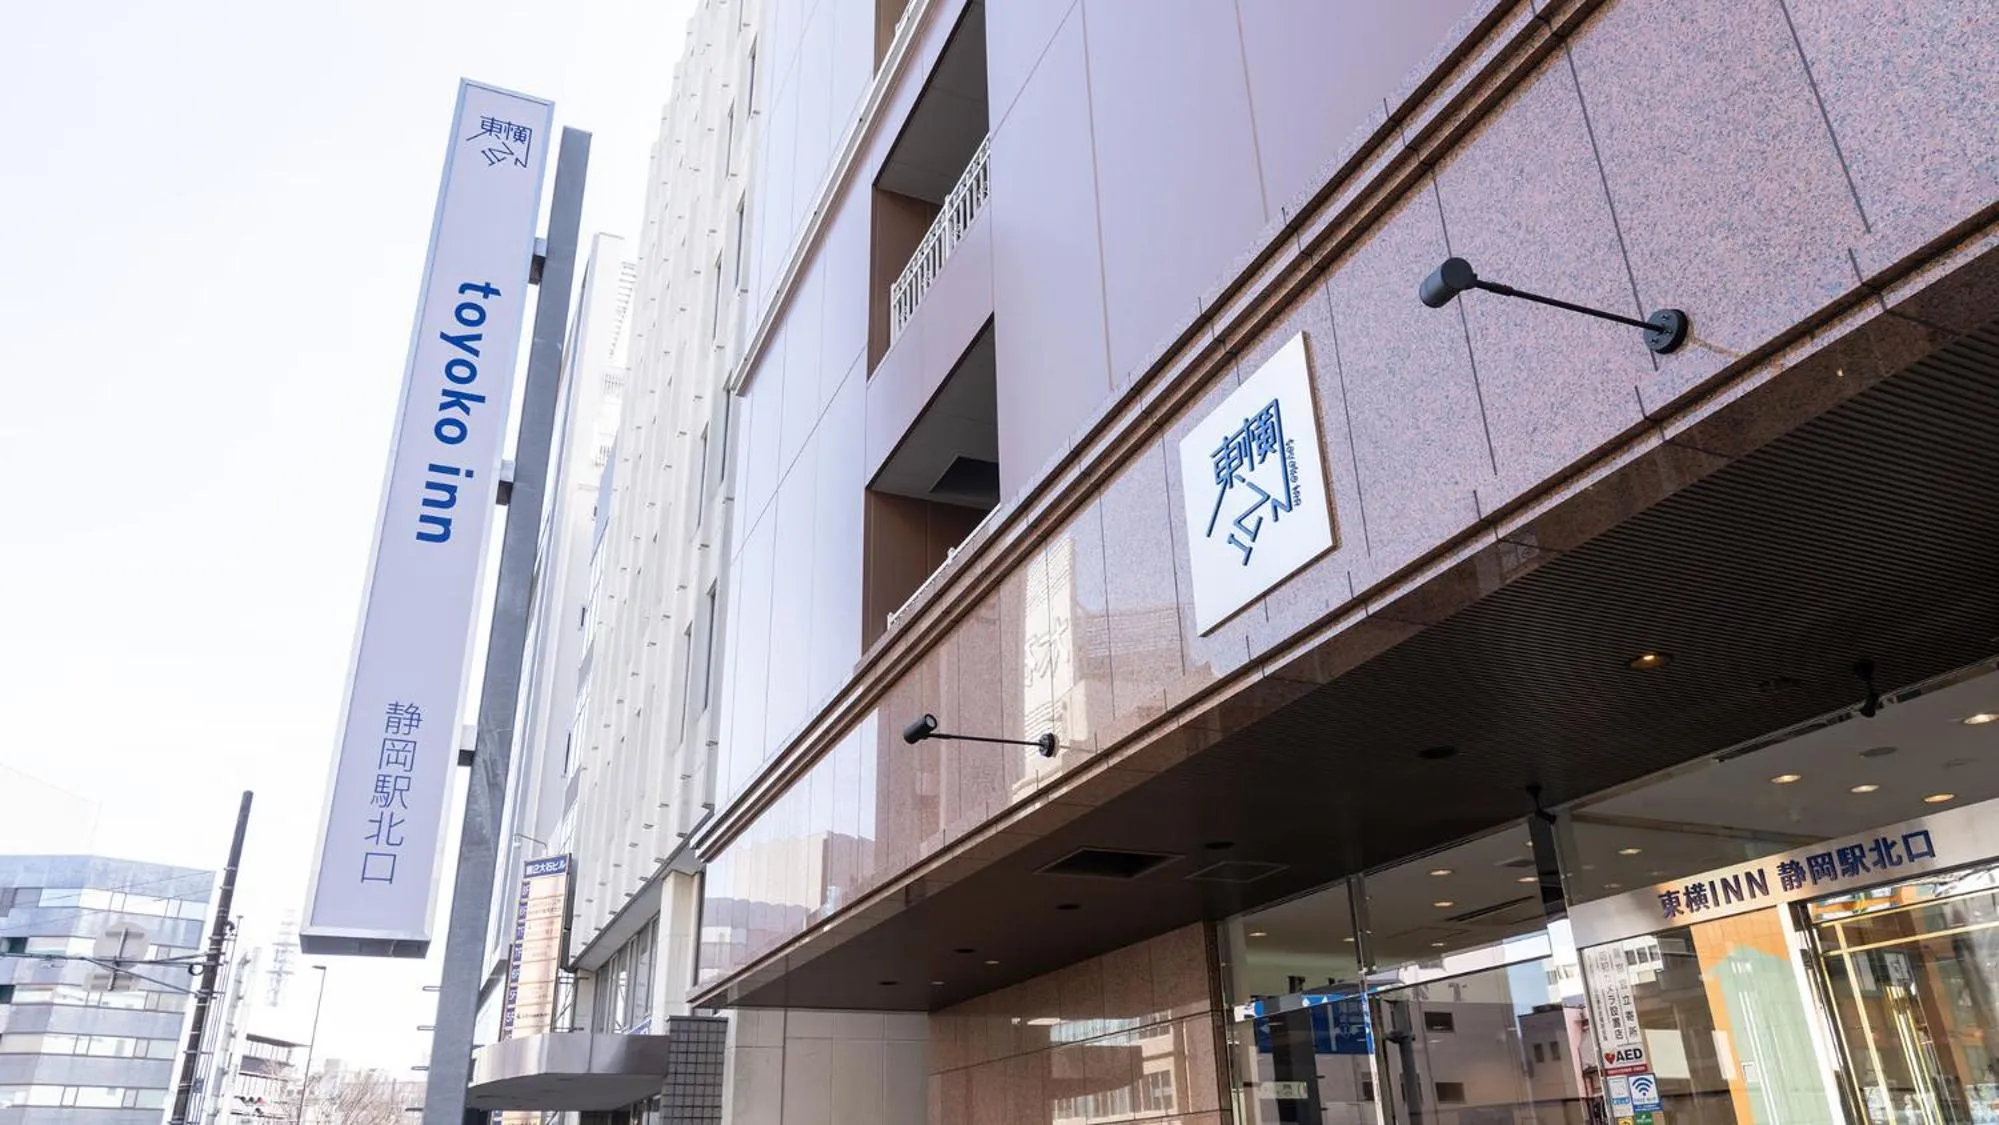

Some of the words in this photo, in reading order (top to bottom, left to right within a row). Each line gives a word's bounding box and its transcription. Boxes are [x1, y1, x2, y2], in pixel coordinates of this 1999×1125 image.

[433, 281, 502, 445] toyoko
[416, 463, 474, 544] inn
[361, 700, 423, 885] 静岡駅北口
[1658, 868, 1768, 919] 東横INN
[1777, 830, 1937, 892] 静岡駅北口
[1616, 1048, 1643, 1062] AED
